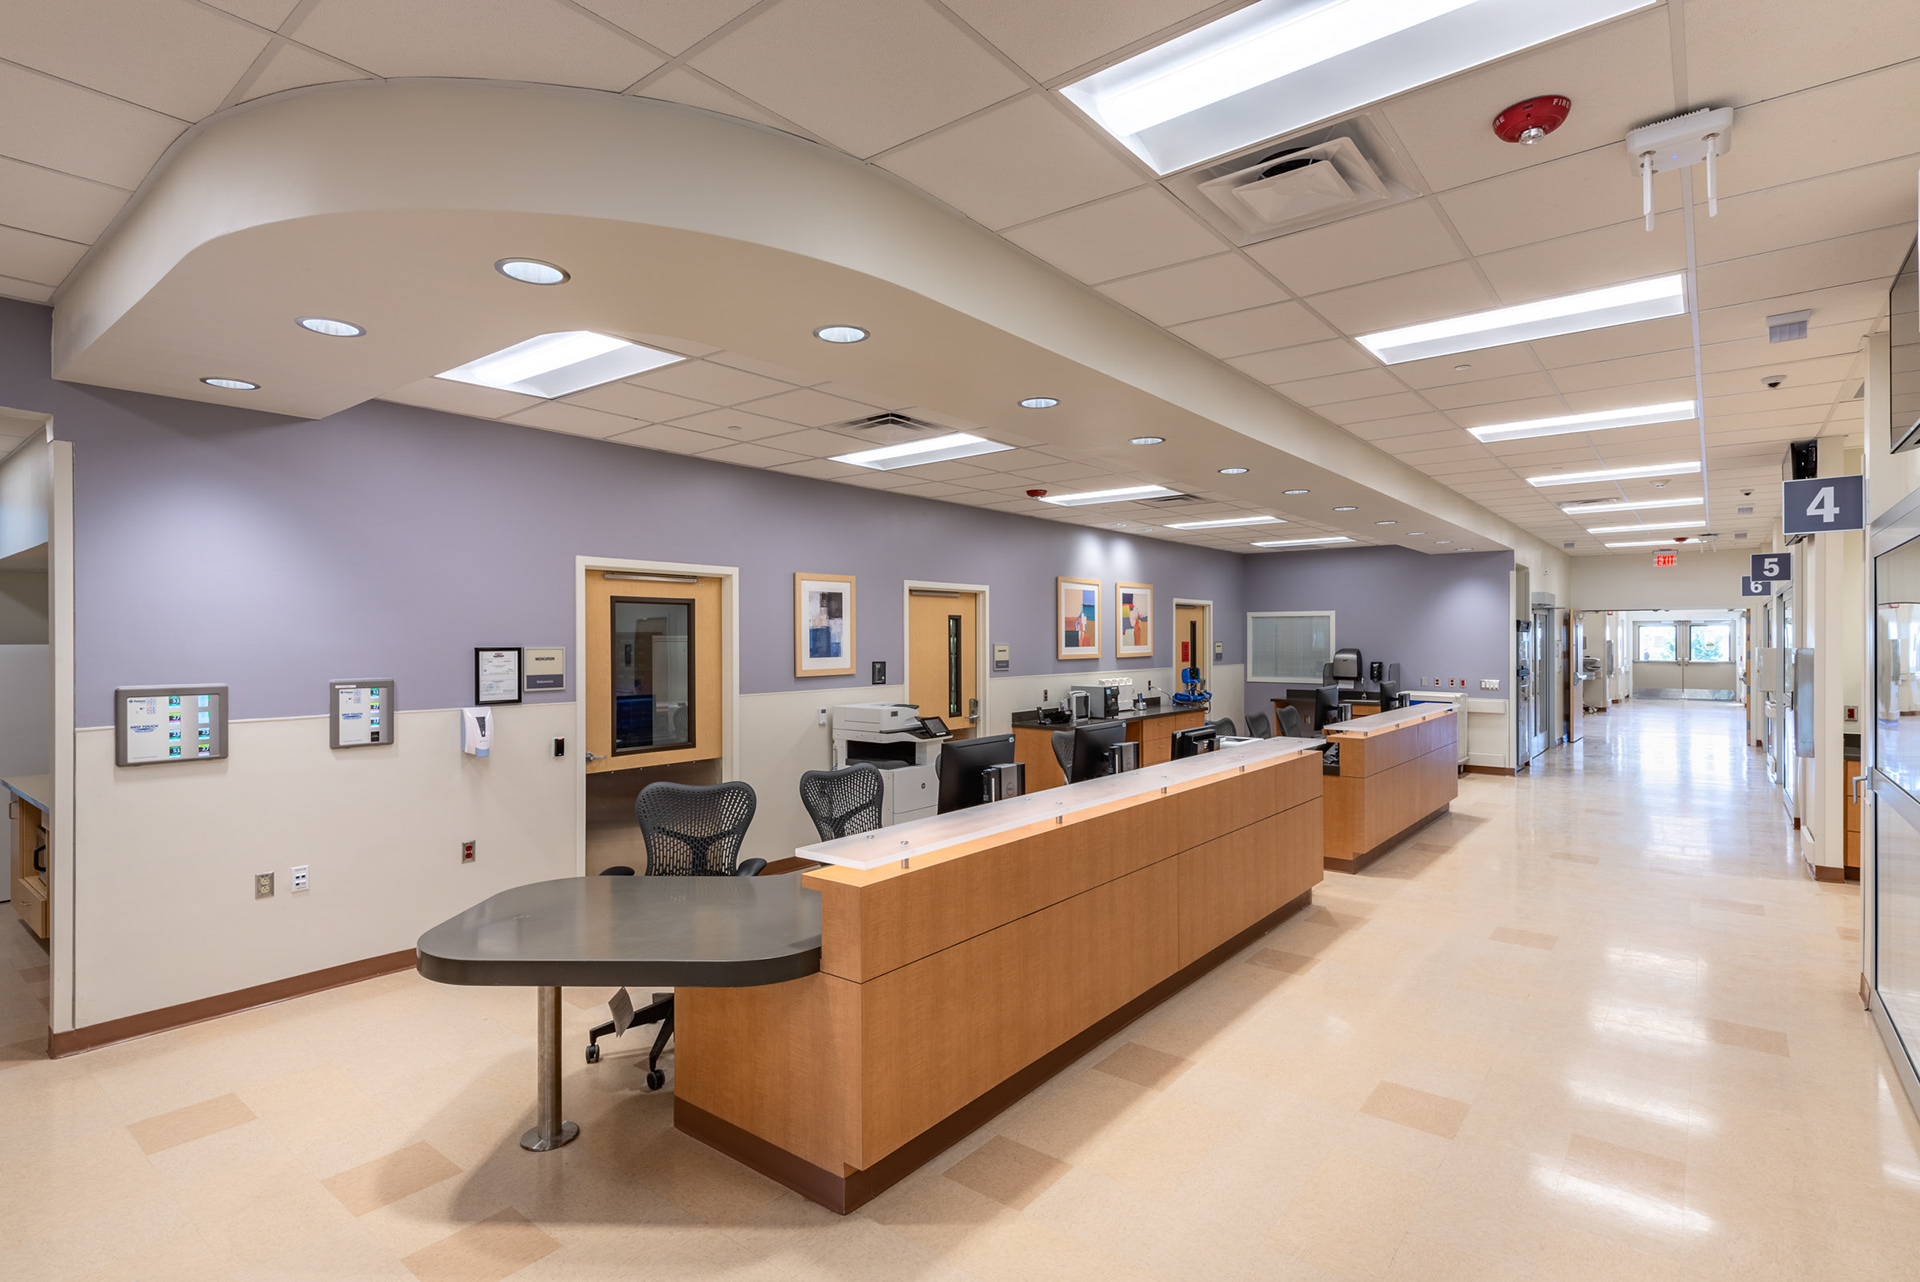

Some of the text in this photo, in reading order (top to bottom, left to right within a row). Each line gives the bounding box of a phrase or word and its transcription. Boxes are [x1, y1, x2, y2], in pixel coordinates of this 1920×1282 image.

[1552, 98, 1571, 109] FIRE
[1806, 486, 1840, 523] 4
[1656, 555, 1676, 567] EXIT
[1762, 557, 1780, 577] 5
[1750, 581, 1763, 593] 6
